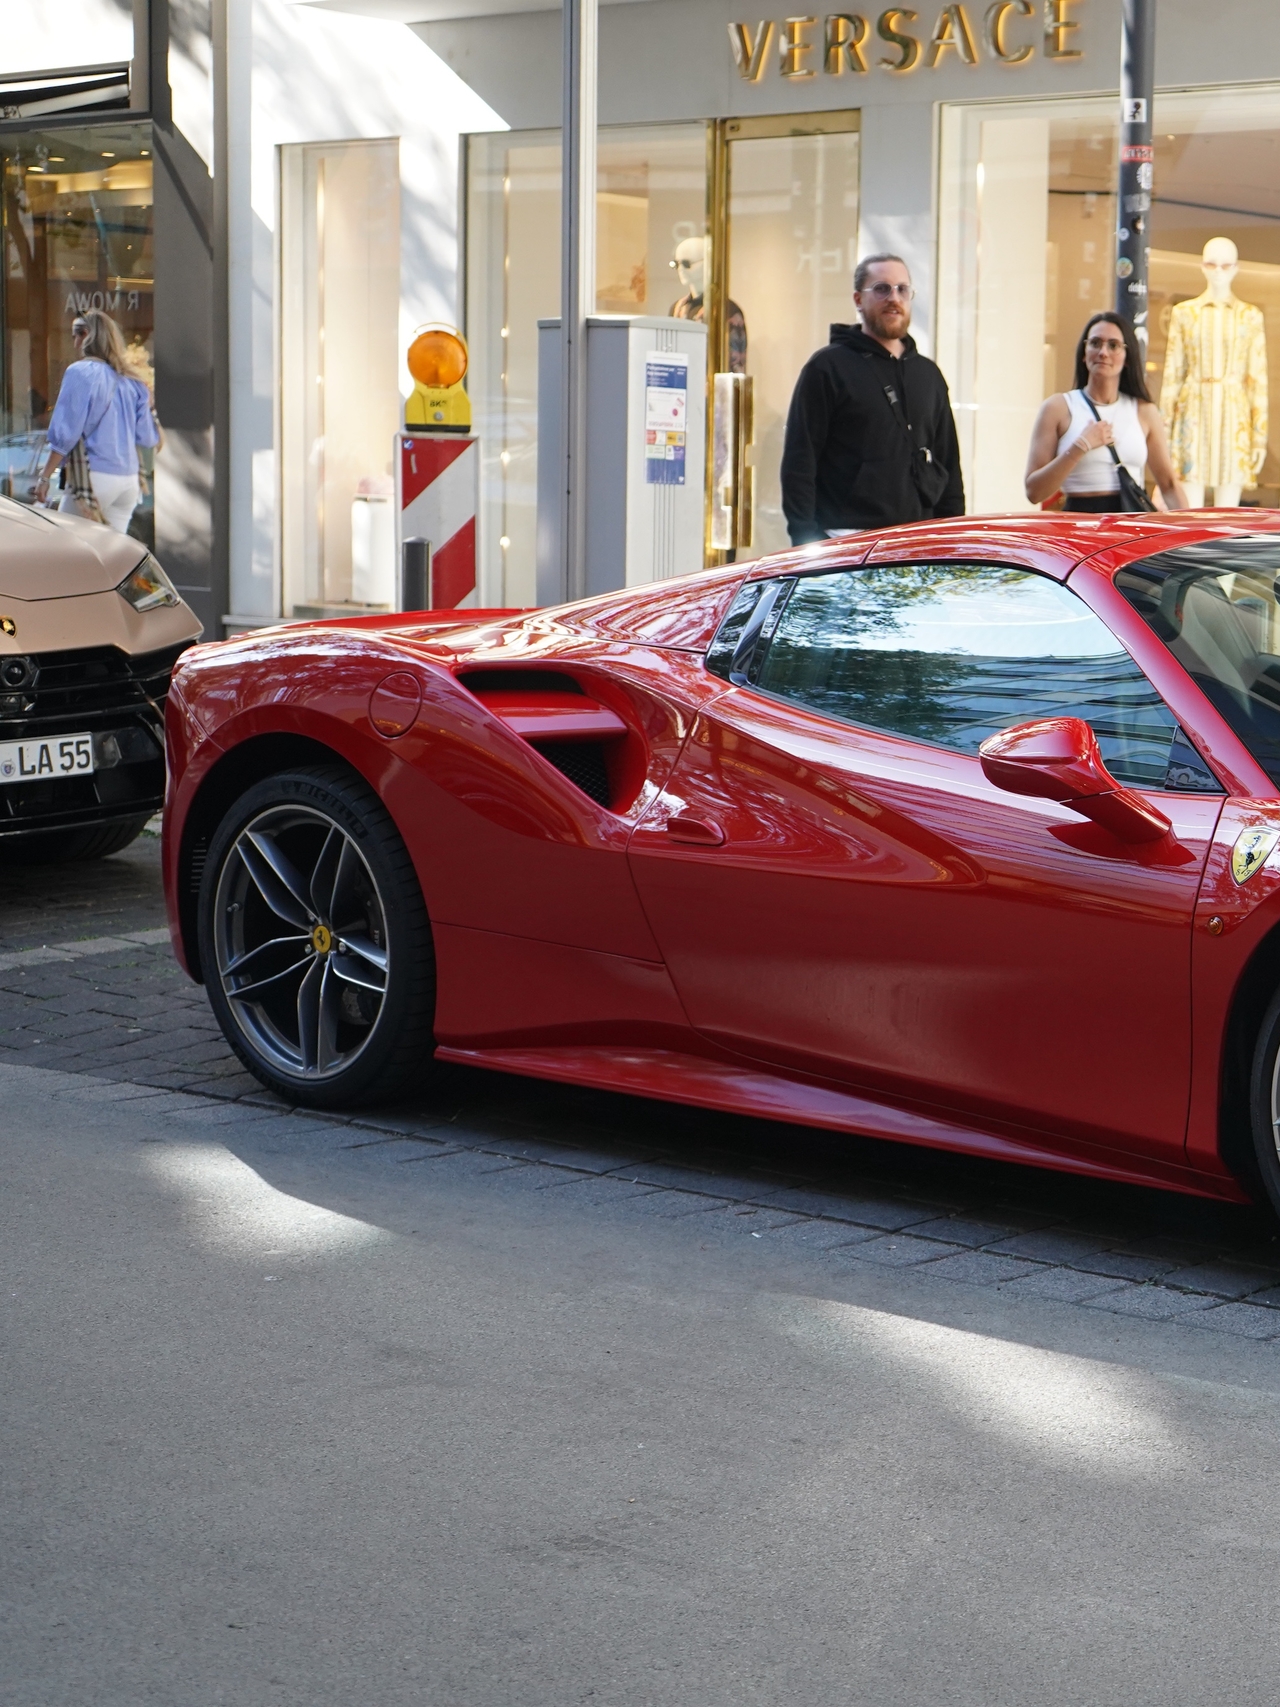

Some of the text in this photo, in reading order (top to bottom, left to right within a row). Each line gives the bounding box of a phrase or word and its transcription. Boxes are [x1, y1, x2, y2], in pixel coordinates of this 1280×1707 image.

[727, 0, 1083, 81] VERSACE
[18, 740, 90, 776] LA 55
[299, 783, 368, 838] MICHELIN
